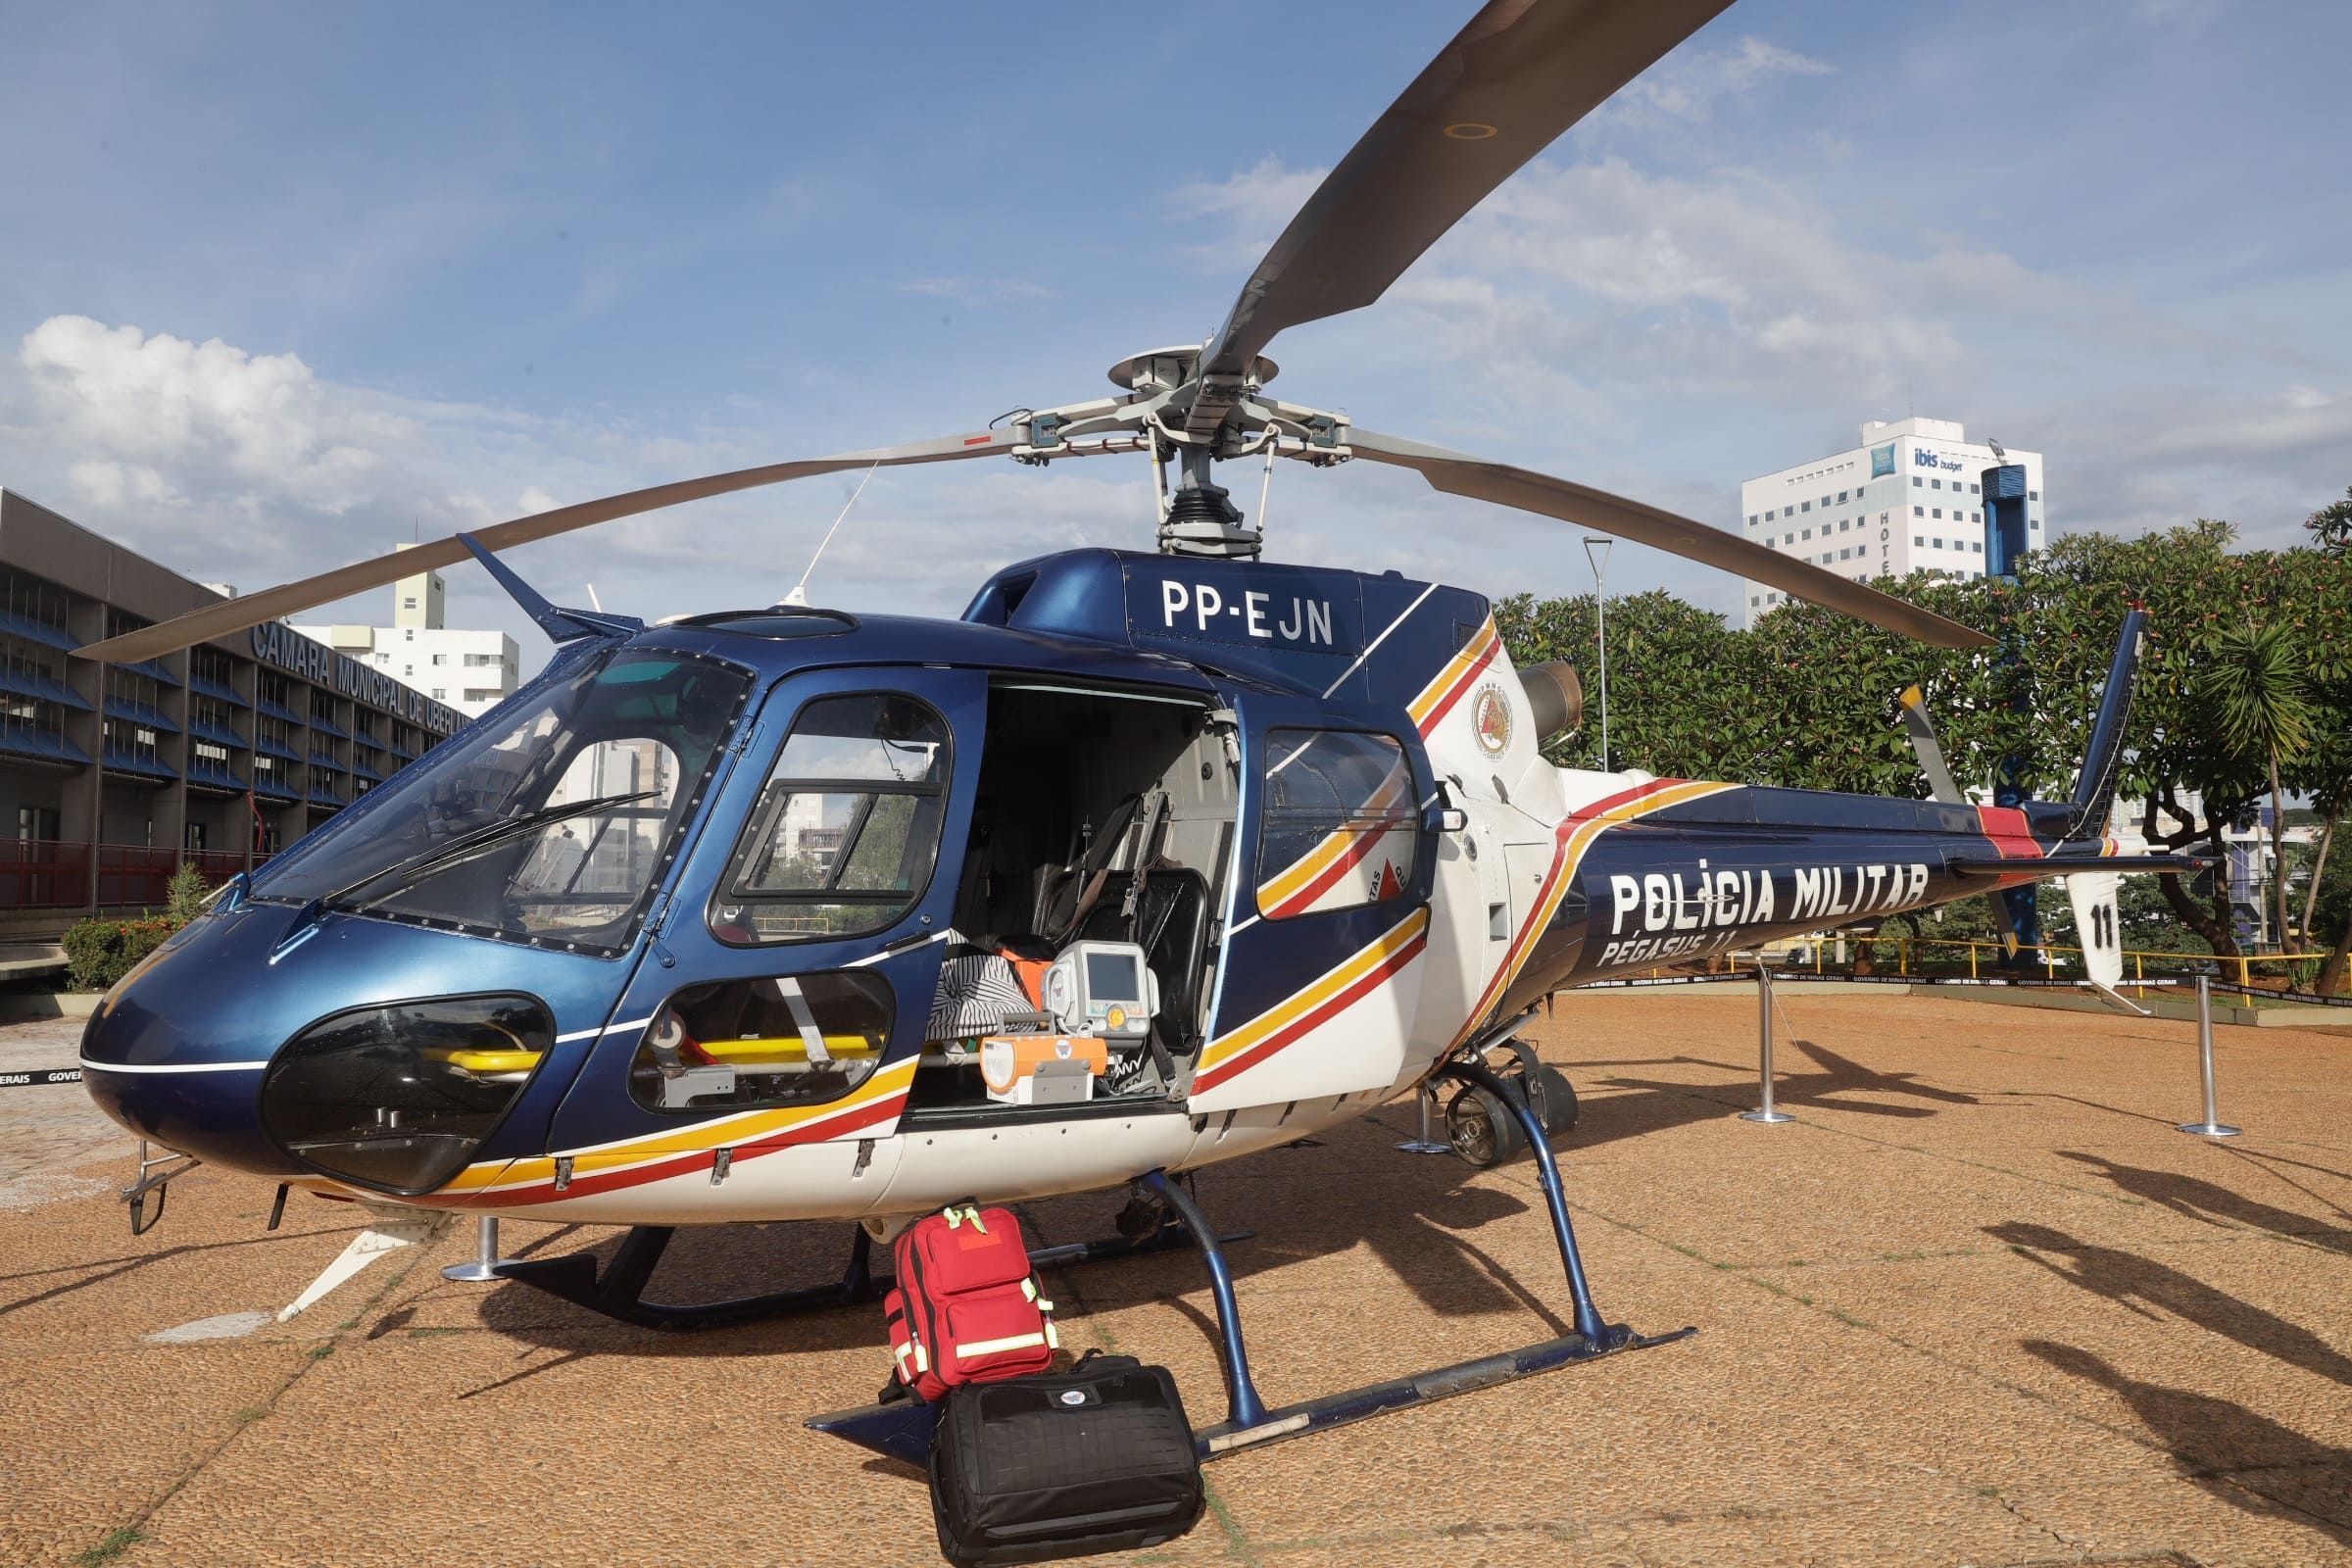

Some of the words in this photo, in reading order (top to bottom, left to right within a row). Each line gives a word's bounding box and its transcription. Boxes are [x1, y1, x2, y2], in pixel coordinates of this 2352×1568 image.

[1914, 448, 1938, 467] ibis
[1940, 461, 1964, 472] budget
[1881, 512, 1889, 574] HOTE
[1162, 580, 1332, 645] PP-EJN
[338, 656, 404, 714] MUNICIPAL
[409, 690, 422, 723] DE
[1396, 866, 1406, 887] QU
[1789, 864, 1929, 920] MILITAR
[1706, 930, 1738, 953] 11
[2090, 904, 2113, 949] 11
[0, 1074, 30, 1084] ERAIS
